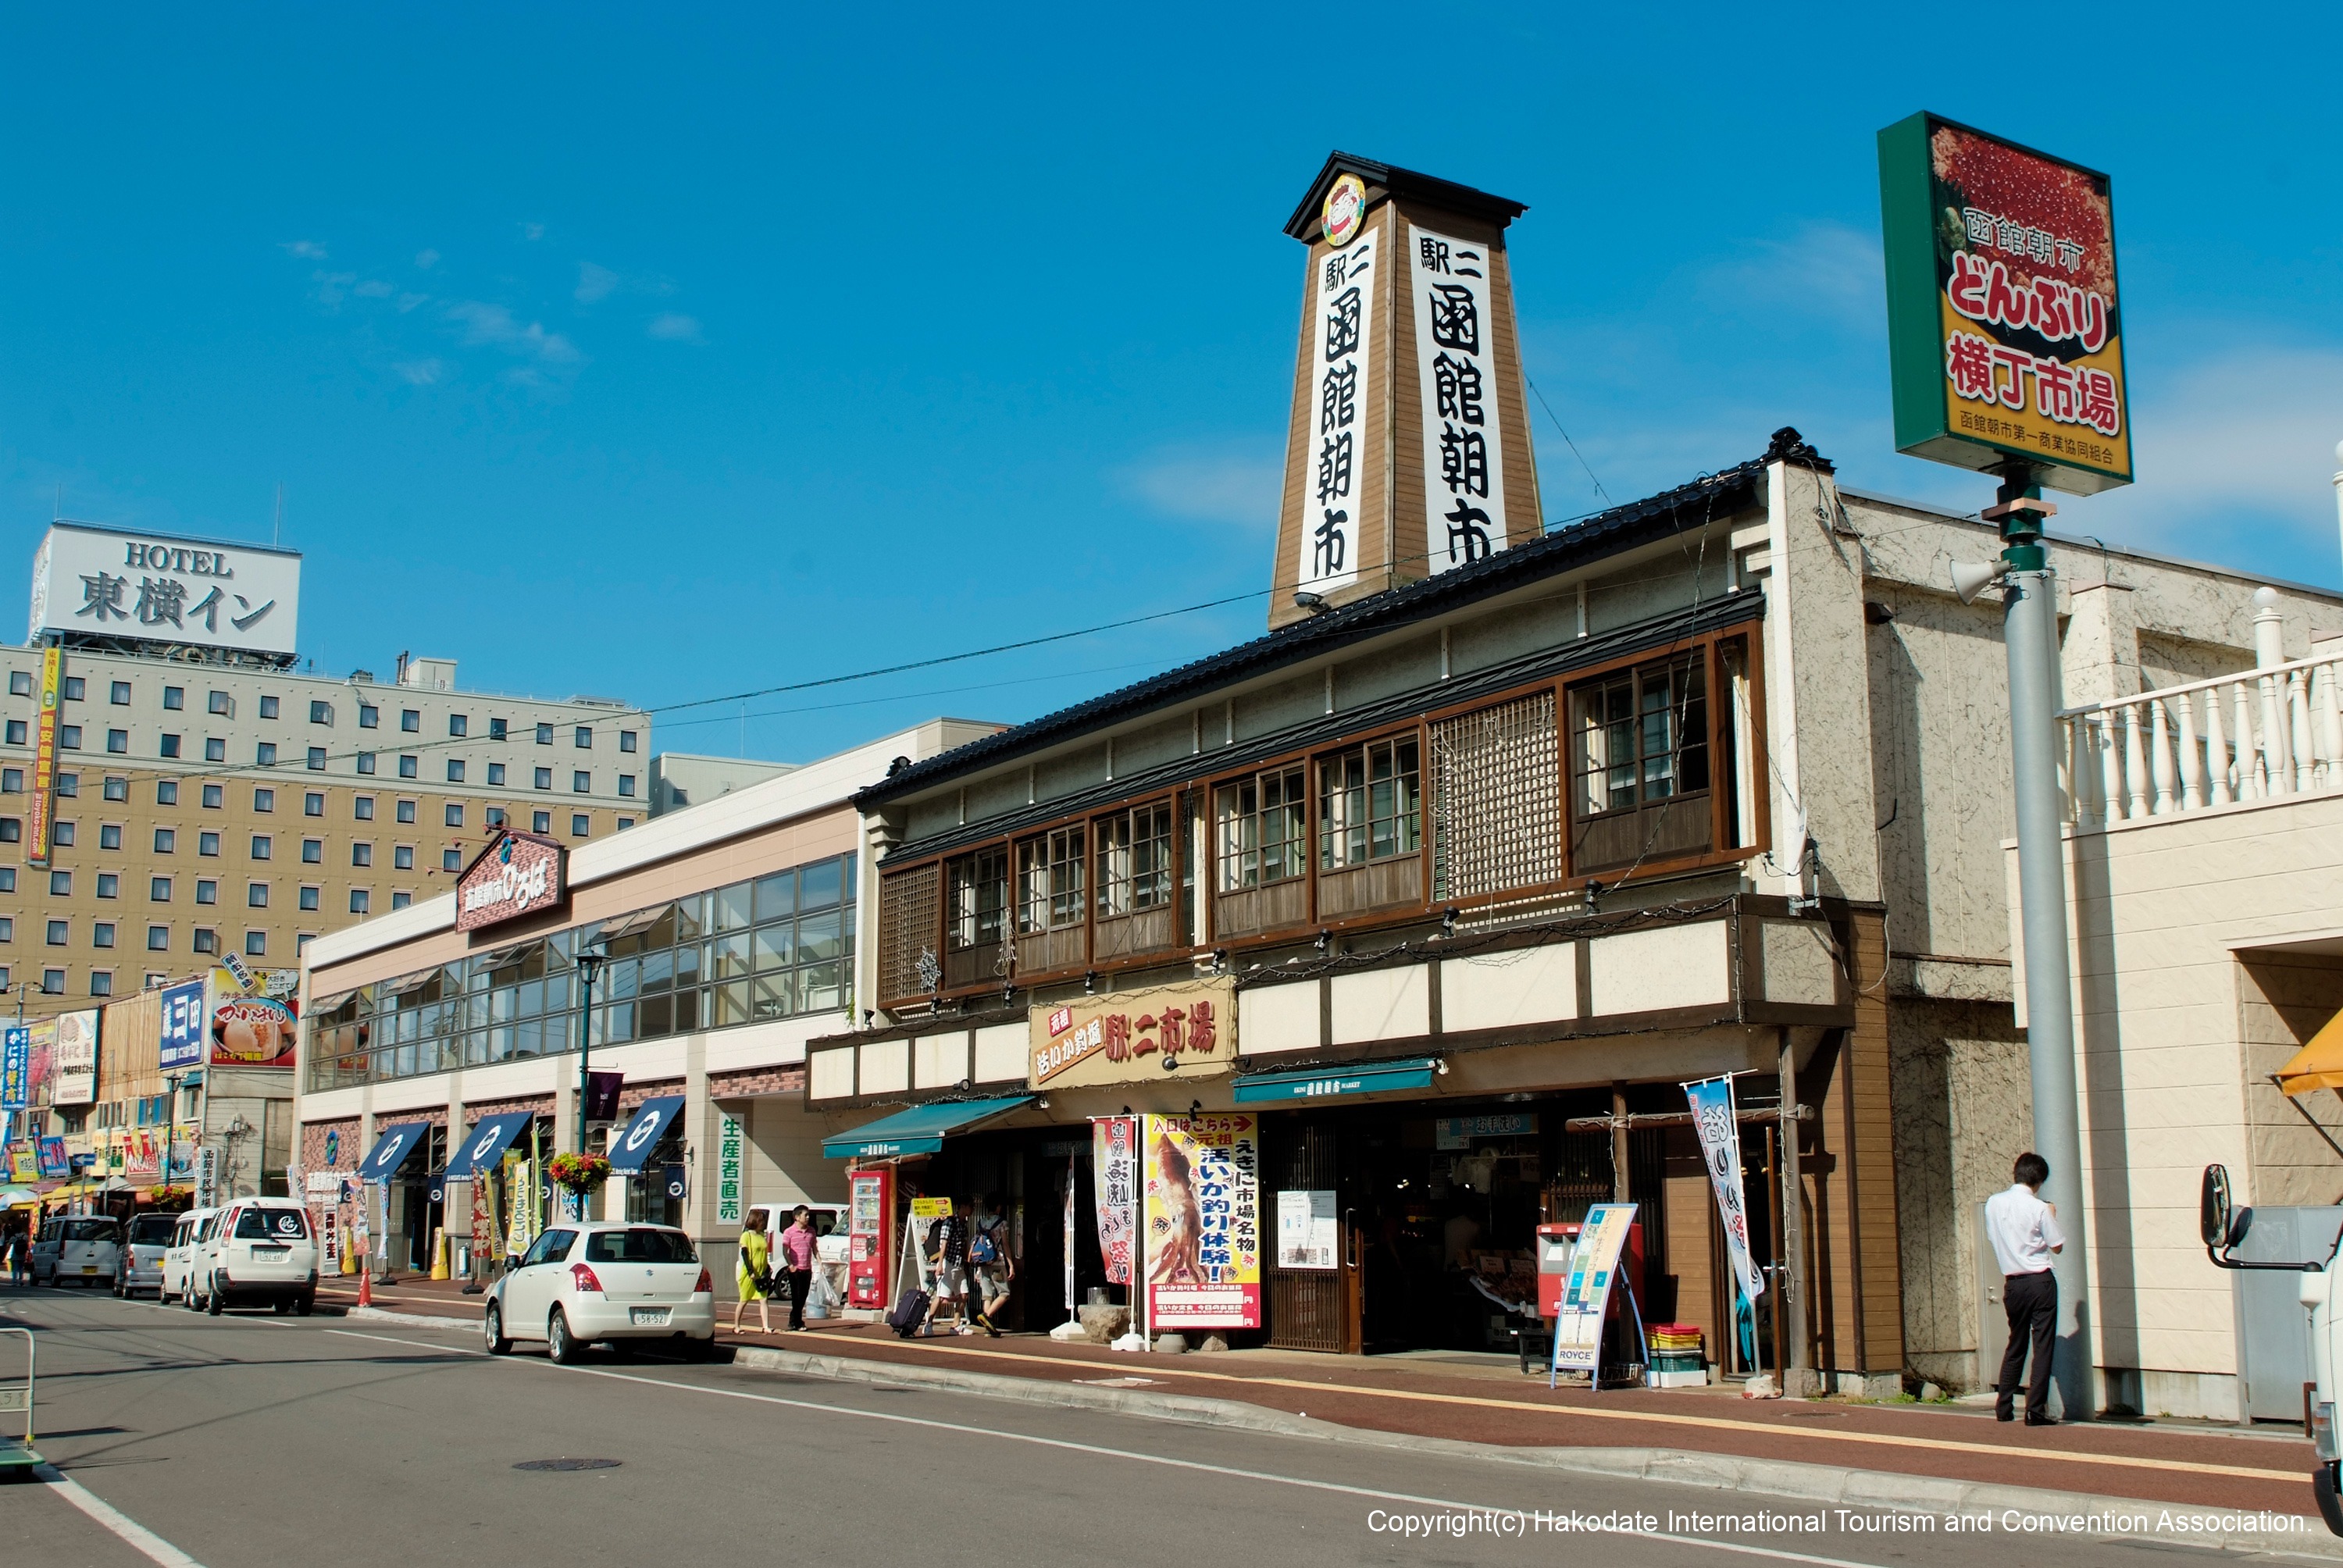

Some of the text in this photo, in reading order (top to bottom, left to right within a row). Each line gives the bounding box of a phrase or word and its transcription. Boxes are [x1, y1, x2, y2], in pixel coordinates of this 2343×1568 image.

[1963, 206, 2084, 274] 函館朝市
[1949, 251, 2106, 351] どんぶり
[1948, 333, 2119, 434] 横丁市場
[1314, 286, 1361, 578] 函館朝市
[1428, 283, 1492, 564] 函館朝市
[1960, 410, 2114, 465] 函館朝市第一商業協同組合
[125, 542, 234, 579] HOTEL
[75, 571, 277, 634] 東横イン
[1036, 1018, 1102, 1077] 活いか釣堀
[1050, 1007, 1070, 1032] 元祖
[1105, 1000, 1215, 1061] 駅二市場
[1154, 1117, 1232, 1132] 入口はこちら
[1196, 1134, 1233, 1146] 元祖
[1476, 1115, 1521, 1133] お手洗い
[720, 1118, 742, 1220] 生産者直売
[1235, 1139, 1256, 1252] えきに市場名物
[1243, 1318, 1254, 1327] 円
